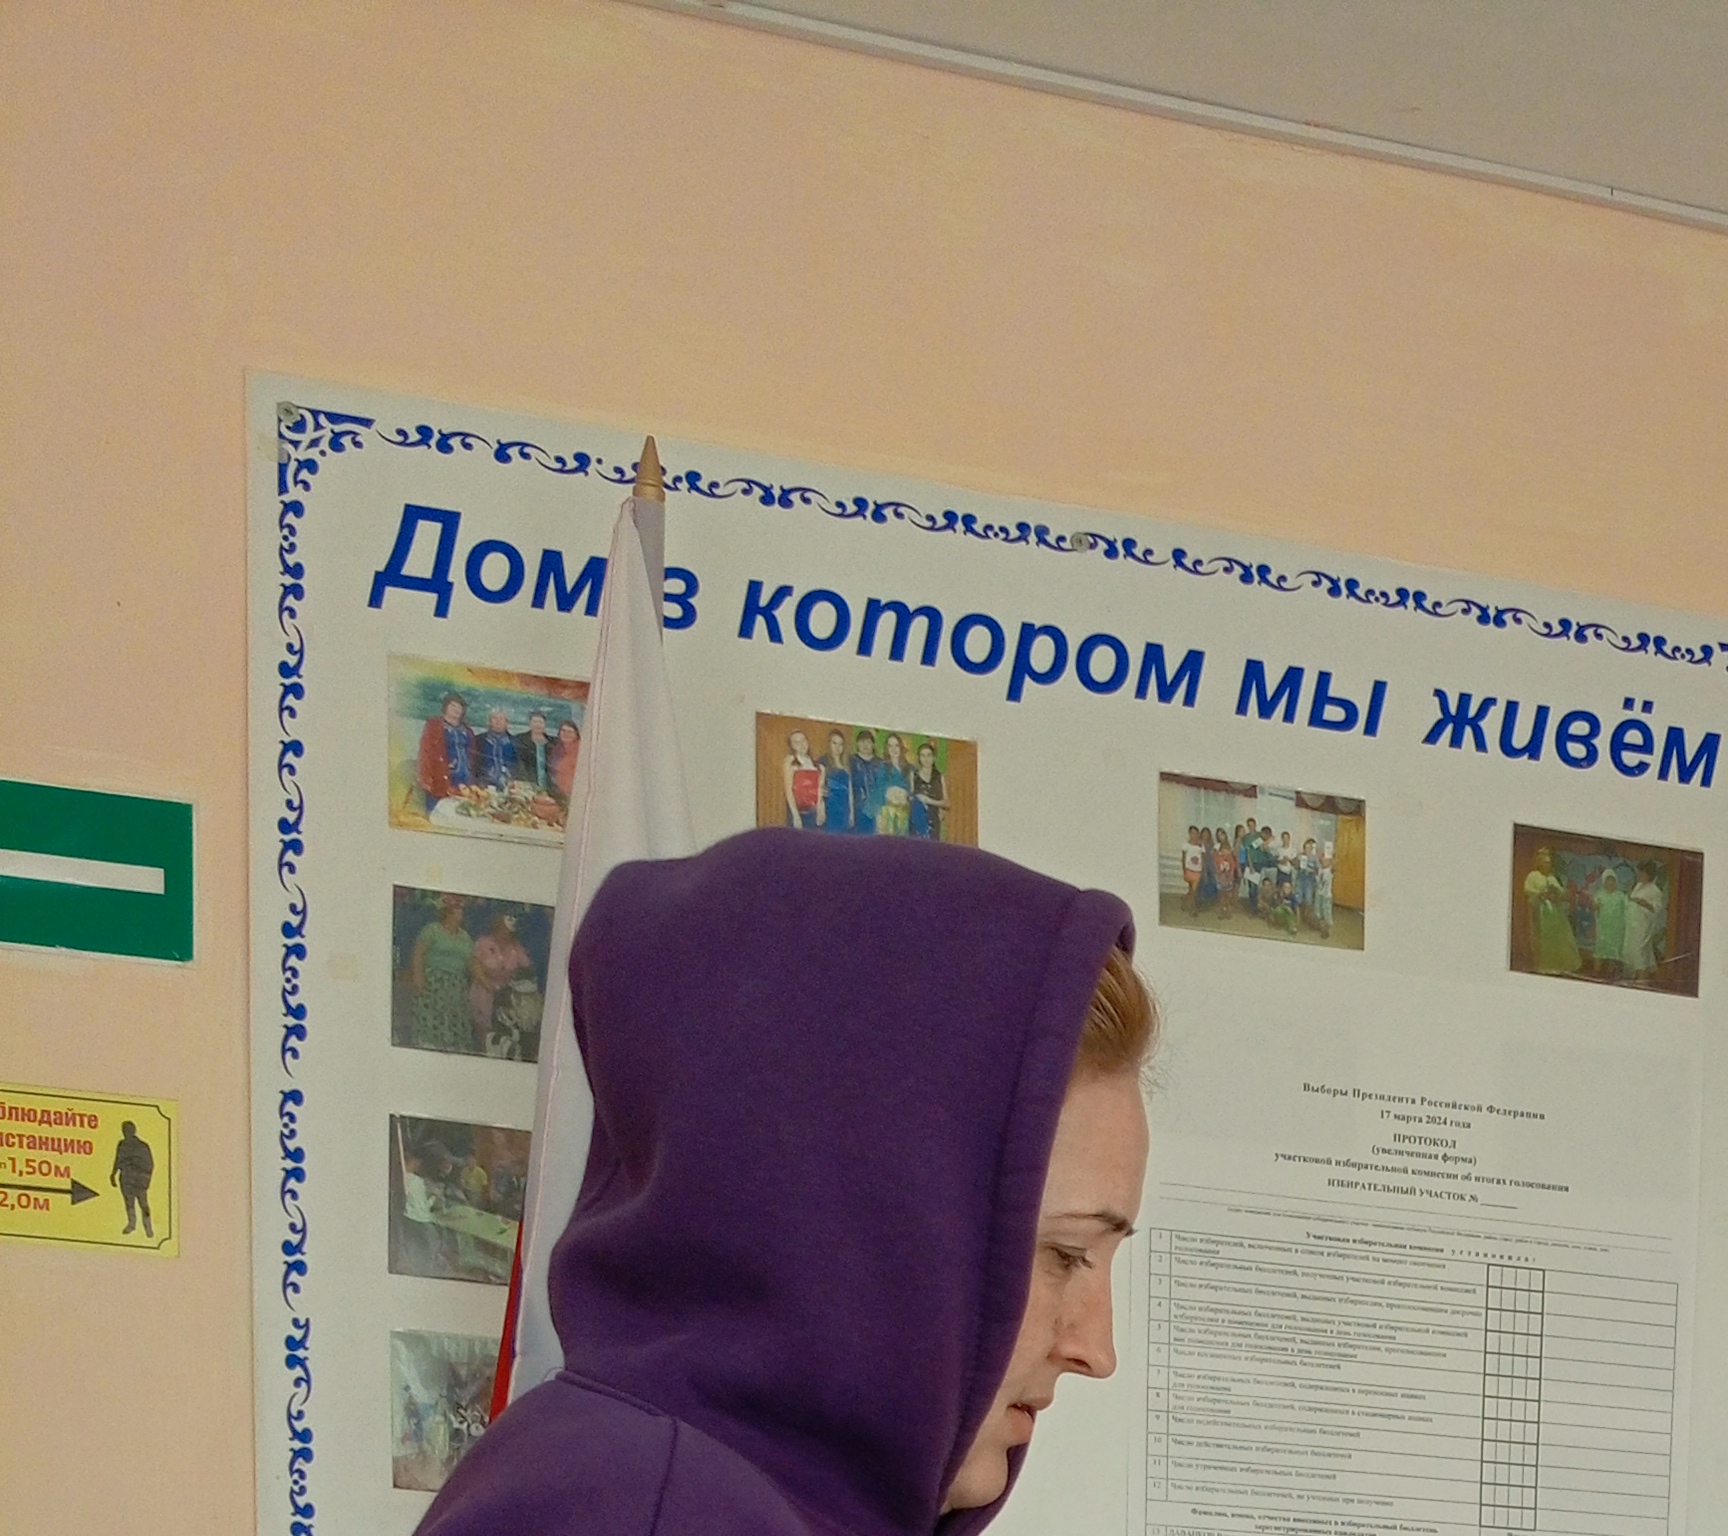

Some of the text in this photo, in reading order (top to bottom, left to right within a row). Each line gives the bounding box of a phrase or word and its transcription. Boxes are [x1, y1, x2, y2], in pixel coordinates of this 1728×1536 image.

[370, 503, 1723, 789] Дом в котором мы живём
[1303, 1083, 1348, 1098] Выборы
[1380, 1110, 1472, 1129] 17 марта 2024 года
[1393, 1134, 1457, 1150] ПРОТОКОЛ
[1441, 1151, 1477, 1166] форма)
[1328, 1178, 1416, 1197] ИЗБИРАТЕЛЬНЫЙ
[1419, 1188, 1466, 1202] УЧАСТОК
